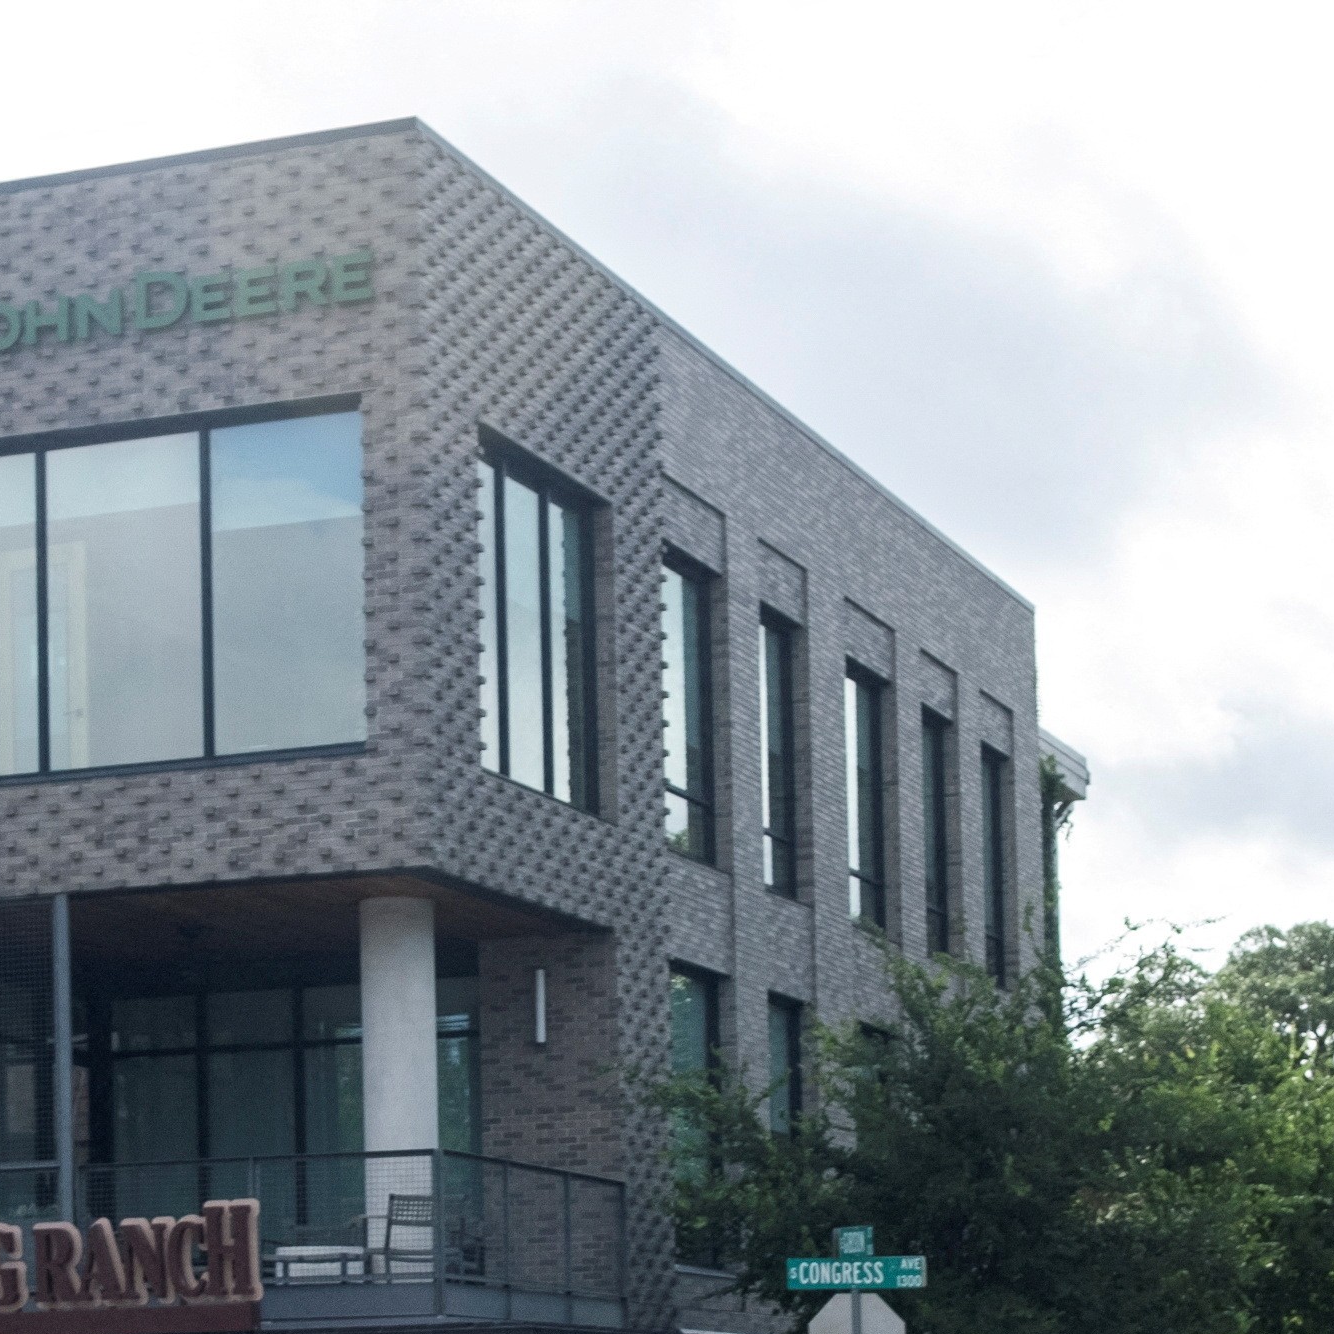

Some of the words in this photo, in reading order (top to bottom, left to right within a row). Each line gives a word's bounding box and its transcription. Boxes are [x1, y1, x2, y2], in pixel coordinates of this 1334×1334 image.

[135, 250, 374, 331] DEERE
[32, 1198, 264, 1309] RANCH
[798, 1261, 884, 1285] CONGRESS
[900, 1258, 921, 1270] AVE
